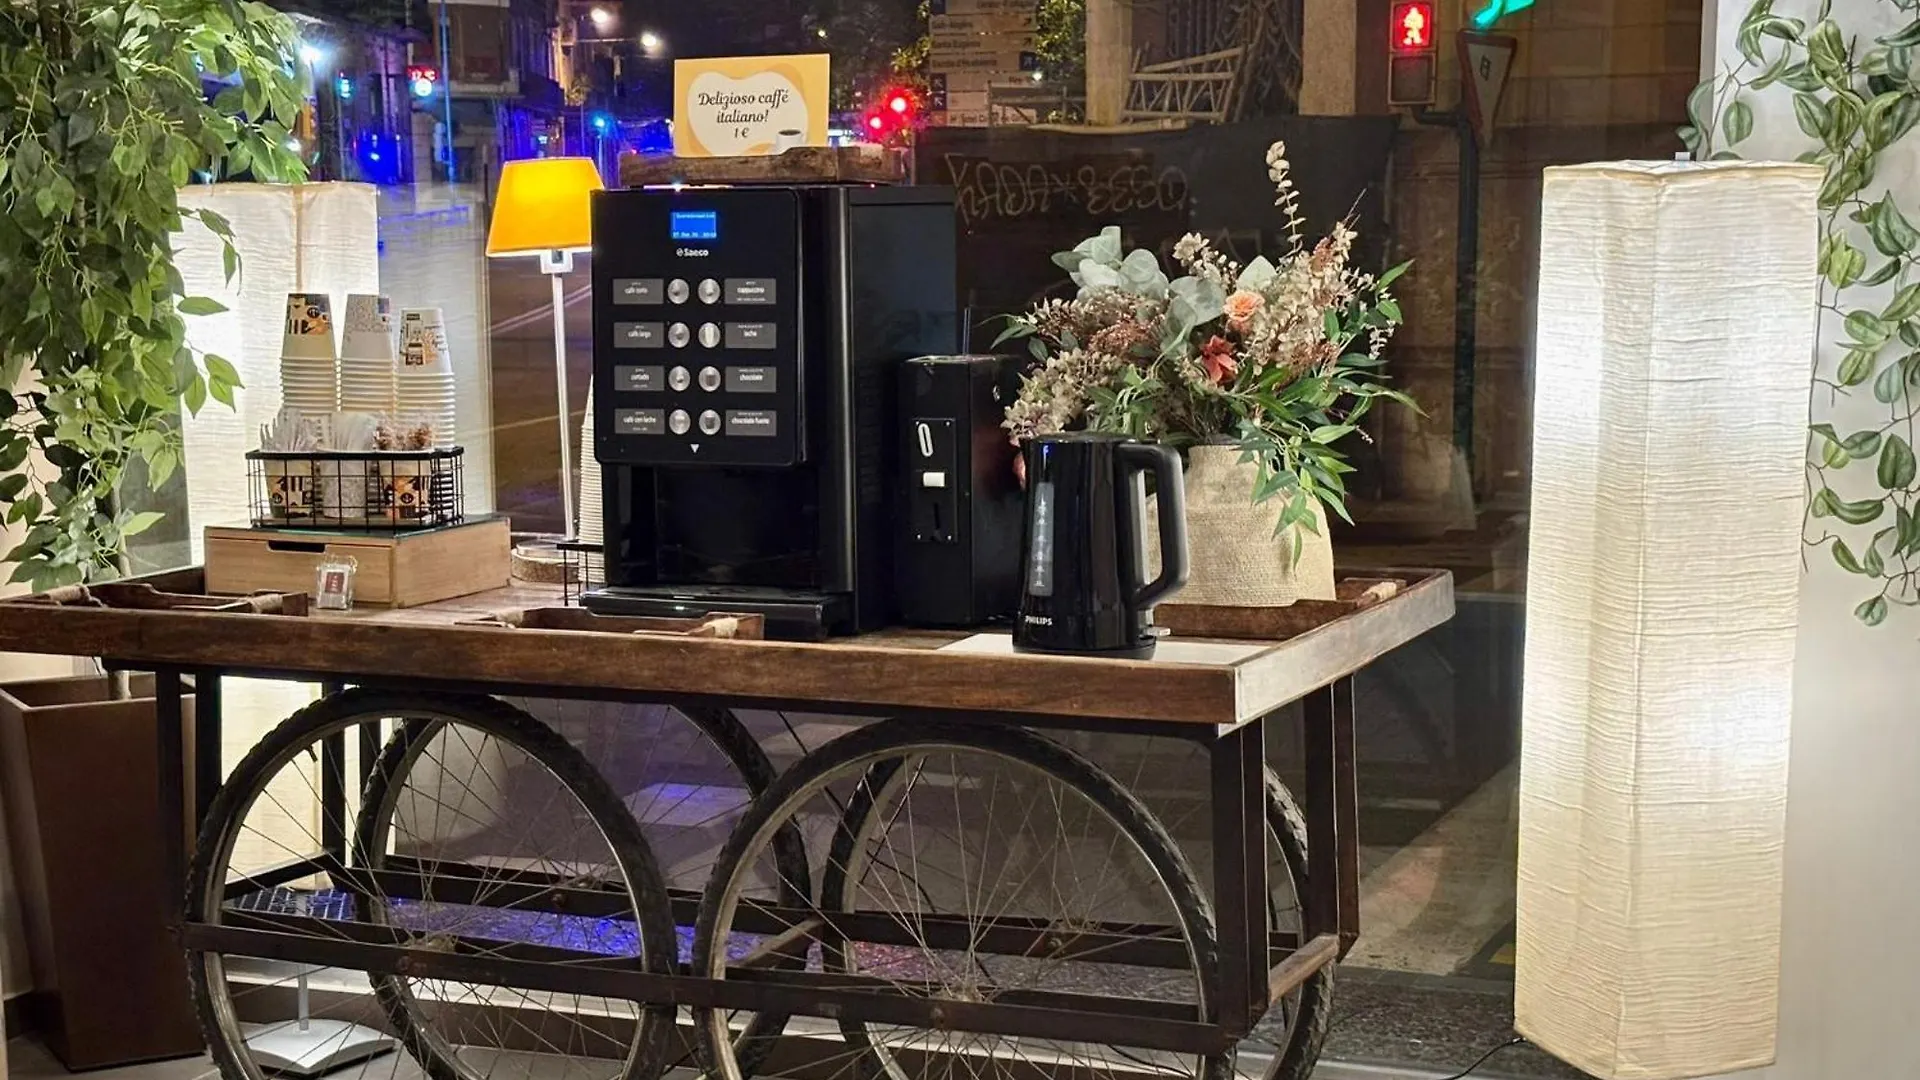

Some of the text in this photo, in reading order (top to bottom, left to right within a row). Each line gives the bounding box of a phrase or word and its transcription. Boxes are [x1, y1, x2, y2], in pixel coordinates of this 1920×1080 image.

[698, 91, 755, 110] Delizioso
[716, 109, 769, 123] italiano!
[735, 127, 739, 138] 1
[683, 248, 709, 257] Saeco
[1024, 615, 1053, 626] PHILIPS
